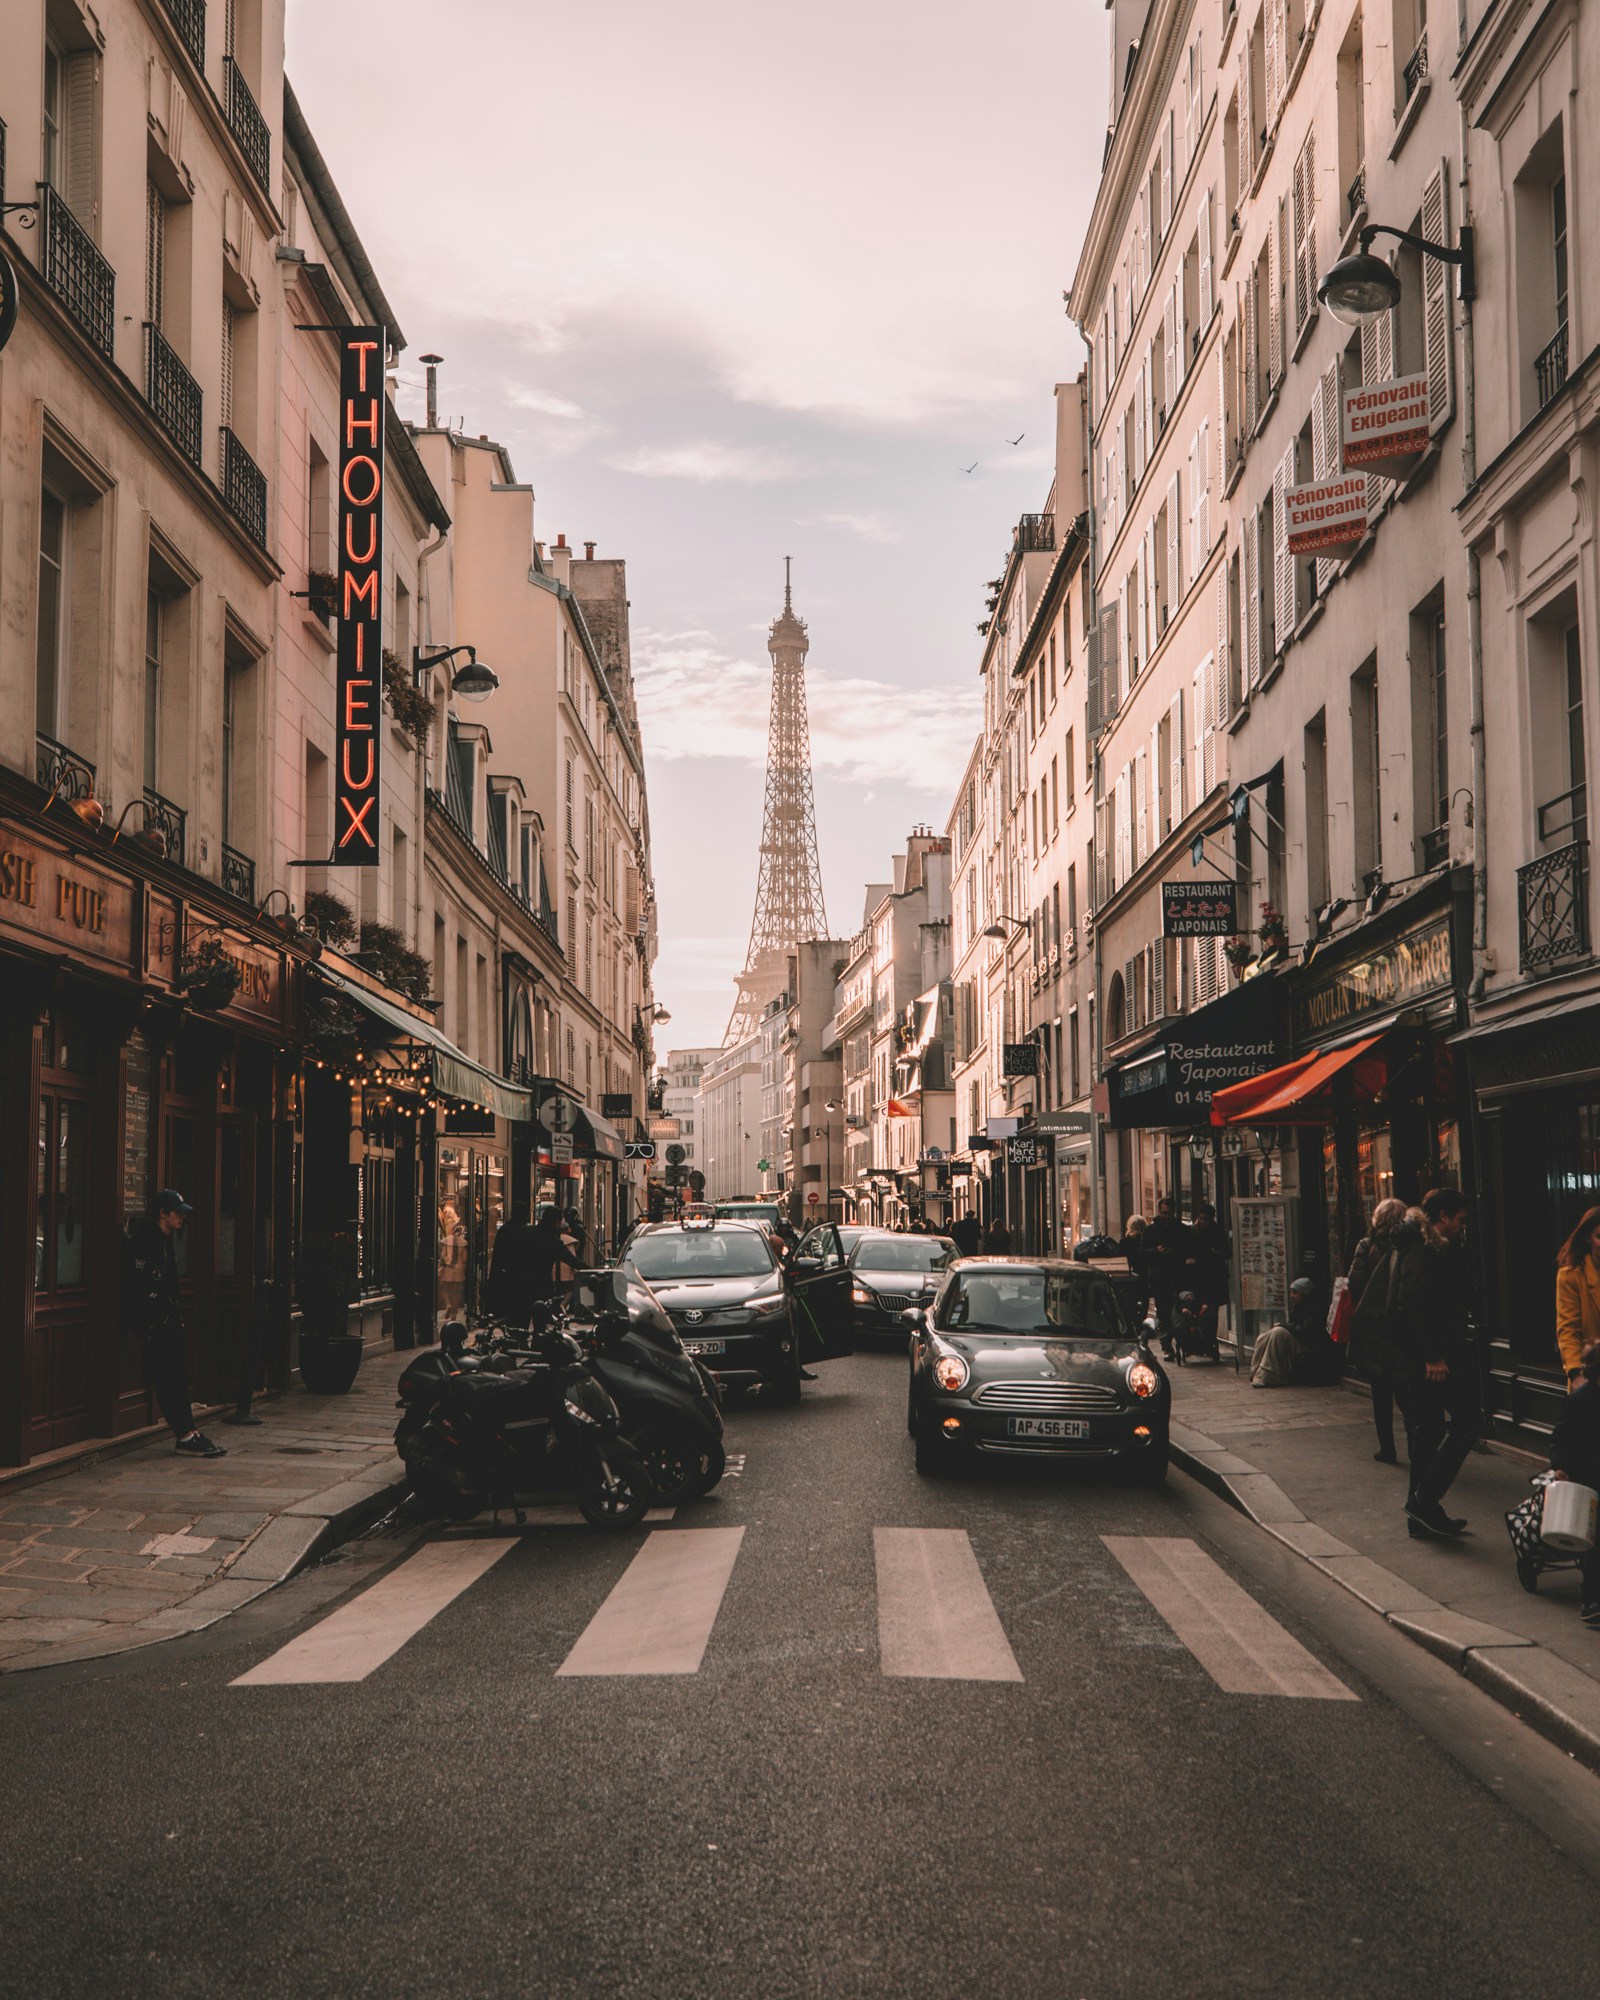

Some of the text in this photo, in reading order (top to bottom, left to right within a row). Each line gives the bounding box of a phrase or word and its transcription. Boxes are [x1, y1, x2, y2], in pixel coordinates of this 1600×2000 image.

[1351, 399, 1429, 432] Exigeant
[1347, 428, 1427, 453] Tél. 09 81 02 20
[1286, 478, 1366, 508] rénovatio
[1290, 519, 1362, 543] Tél. 09 81 02 20
[339, 341, 379, 847] THOUMIEUX
[1164, 884, 1232, 898] RESTAURANT
[55, 873, 104, 935] PUB
[1167, 900, 1231, 918] とよたか
[1171, 920, 1228, 933] JAPONAIS
[1308, 980, 1351, 1028] MOULIN
[1009, 1047, 1034, 1057] Karl
[1168, 1040, 1275, 1060] Restaurant
[1005, 1055, 1034, 1065] Marc
[1005, 1063, 1035, 1073] John
[1180, 1062, 1266, 1085] Japonais
[1175, 1090, 1212, 1104] 01 45
[1009, 1147, 1035, 1156] Marc
[1013, 1139, 1035, 1148] Karl
[1009, 1155, 1035, 1163] John
[1017, 1420, 1080, 1436] AP-456-EH
